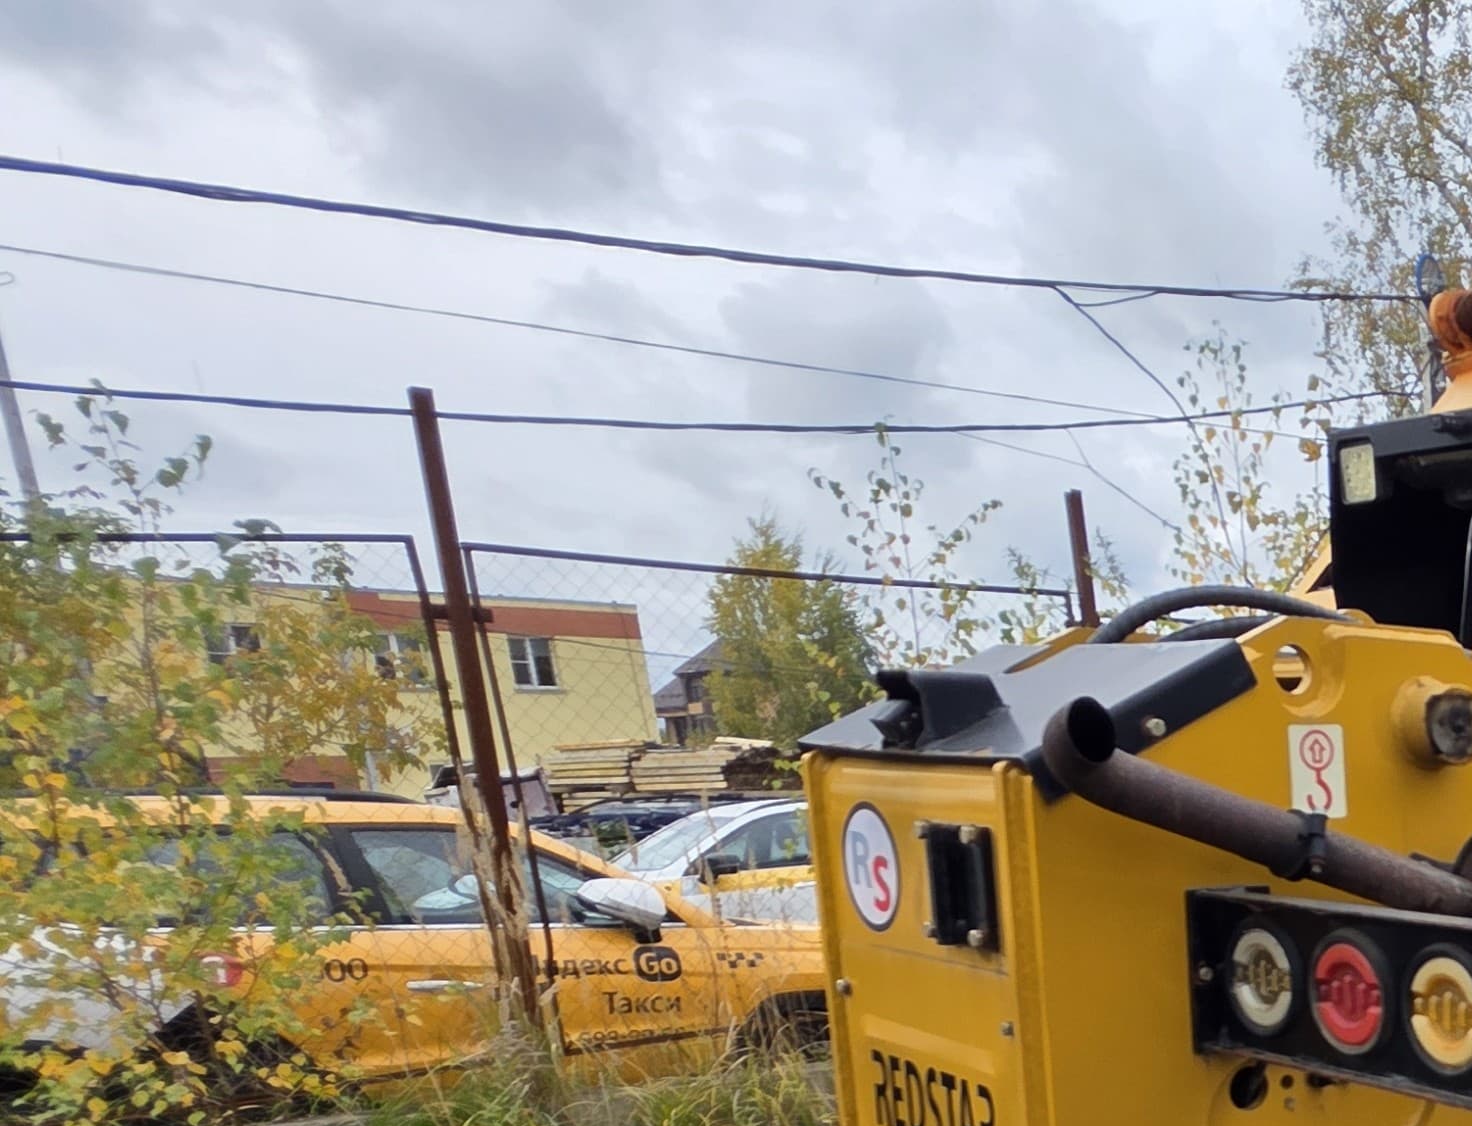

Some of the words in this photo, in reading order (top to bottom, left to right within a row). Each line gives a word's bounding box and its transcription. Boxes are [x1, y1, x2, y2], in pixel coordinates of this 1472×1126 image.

[850, 830, 892, 912] RS
[638, 952, 678, 976] Go
[602, 991, 682, 1014] Такси
